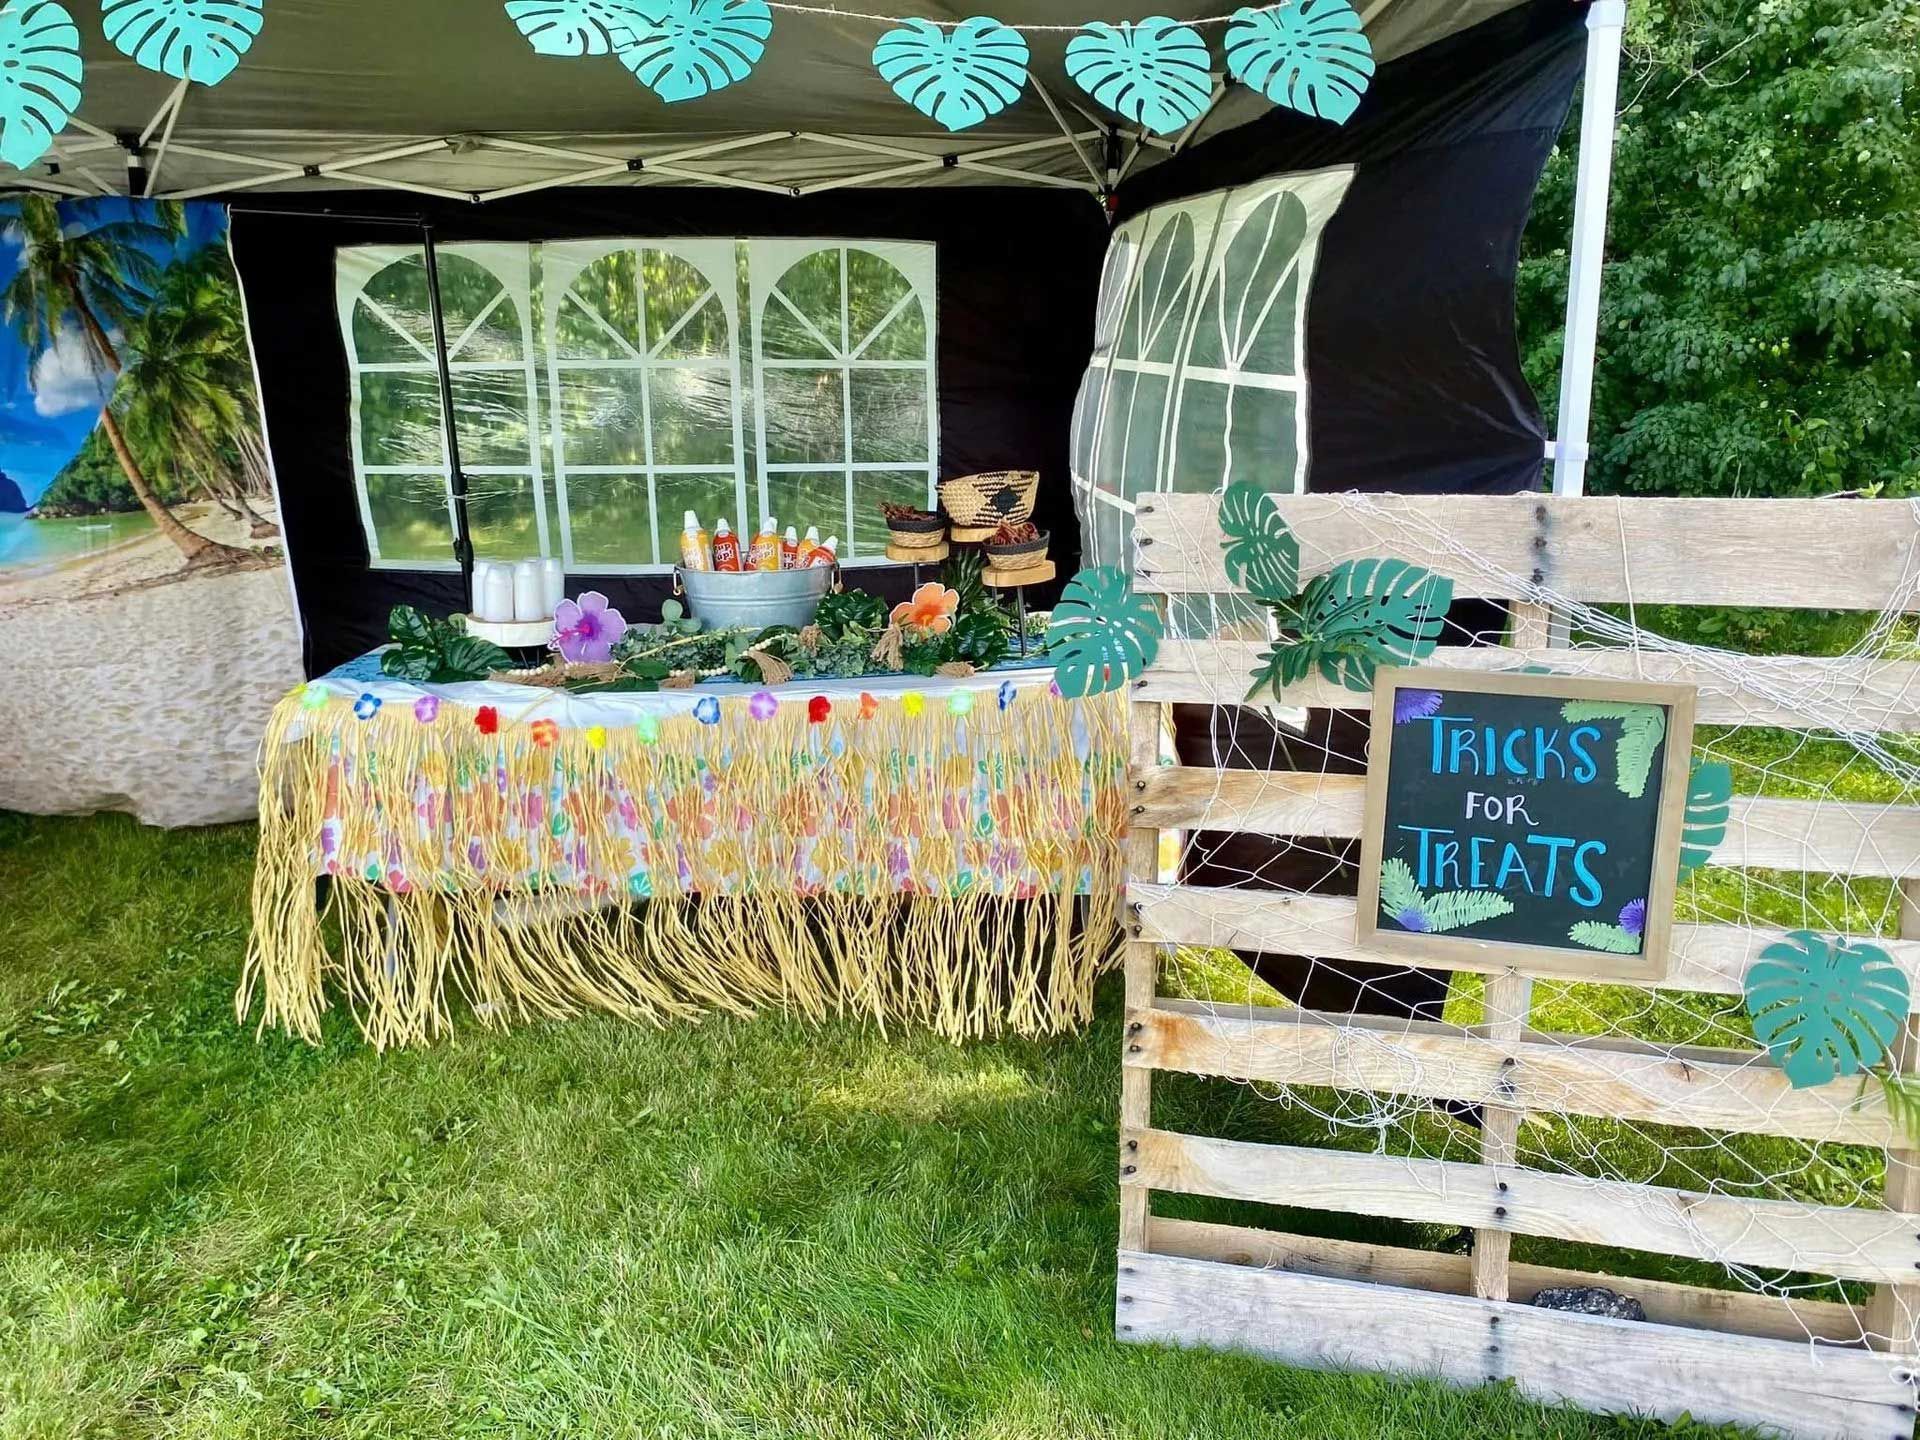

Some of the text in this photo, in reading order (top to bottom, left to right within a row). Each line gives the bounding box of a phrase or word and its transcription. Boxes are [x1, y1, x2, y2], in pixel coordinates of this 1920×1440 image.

[1412, 716, 1601, 783] TRICKS
[1465, 791, 1539, 826] FOR
[1398, 825, 1607, 907] TREATS
